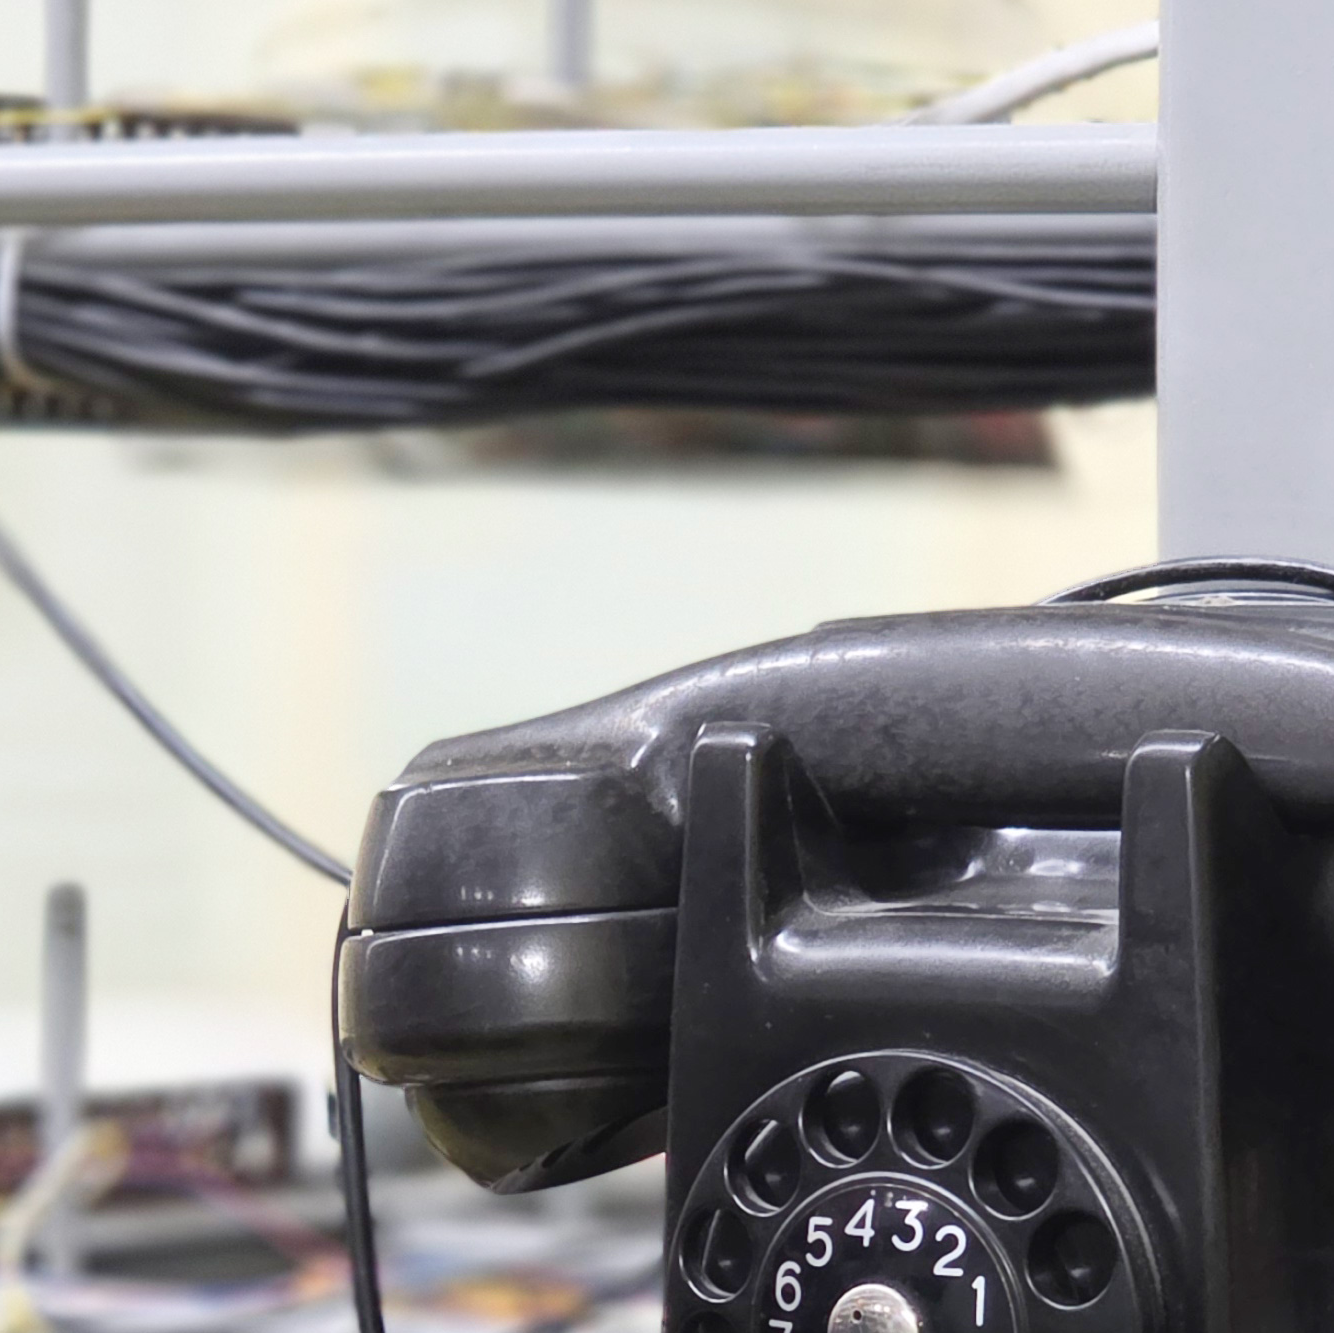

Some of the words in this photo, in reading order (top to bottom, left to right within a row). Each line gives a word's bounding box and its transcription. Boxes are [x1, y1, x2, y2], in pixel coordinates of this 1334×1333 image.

[805, 1215, 834, 1268] 5
[843, 1198, 876, 1248] 4
[891, 1201, 929, 1252] 3
[932, 1224, 967, 1278] 2
[775, 1260, 802, 1312] 6
[970, 1275, 986, 1327] 1
